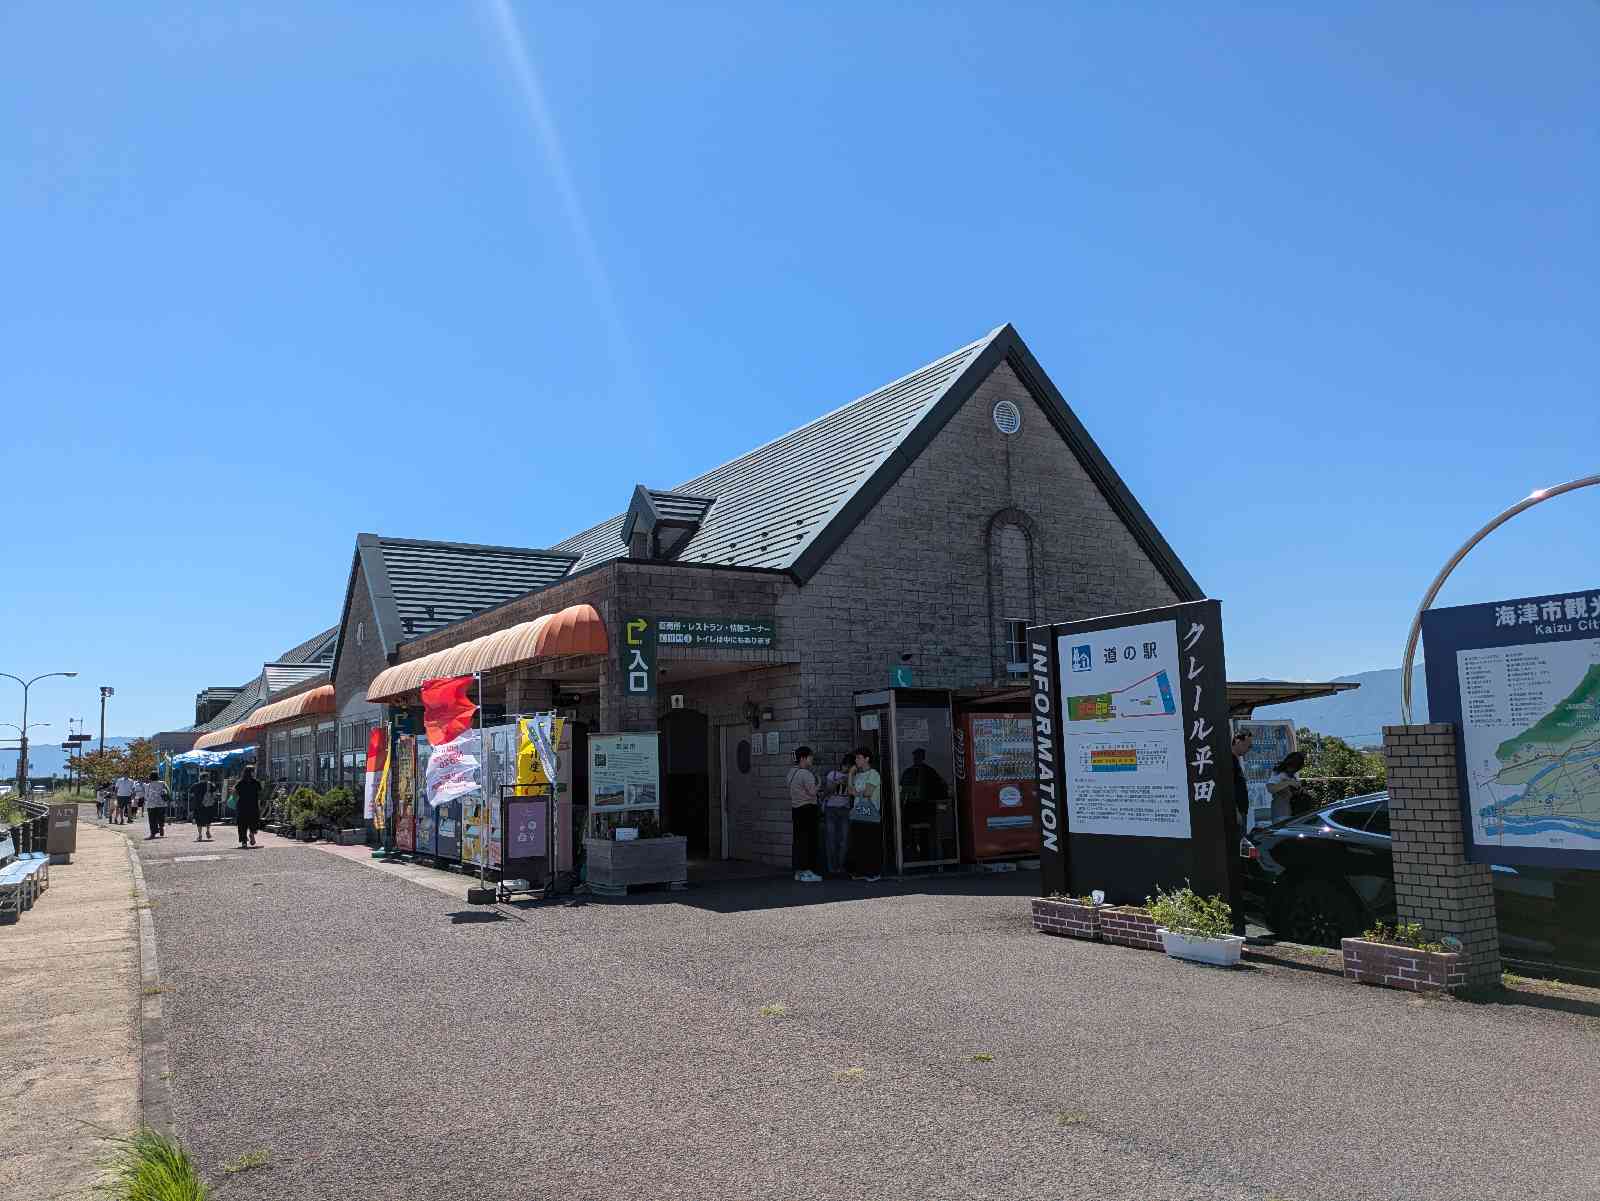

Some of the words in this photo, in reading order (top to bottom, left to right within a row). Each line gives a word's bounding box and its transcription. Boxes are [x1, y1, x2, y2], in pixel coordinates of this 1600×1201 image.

[1535, 623, 1572, 635] Kaizu
[1578, 620, 1600, 631] Cit
[628, 649, 649, 692] 入口
[1103, 641, 1158, 664] 道の駅
[1183, 622, 1216, 803] クレール平田
[1032, 642, 1059, 853] INFORMATION
